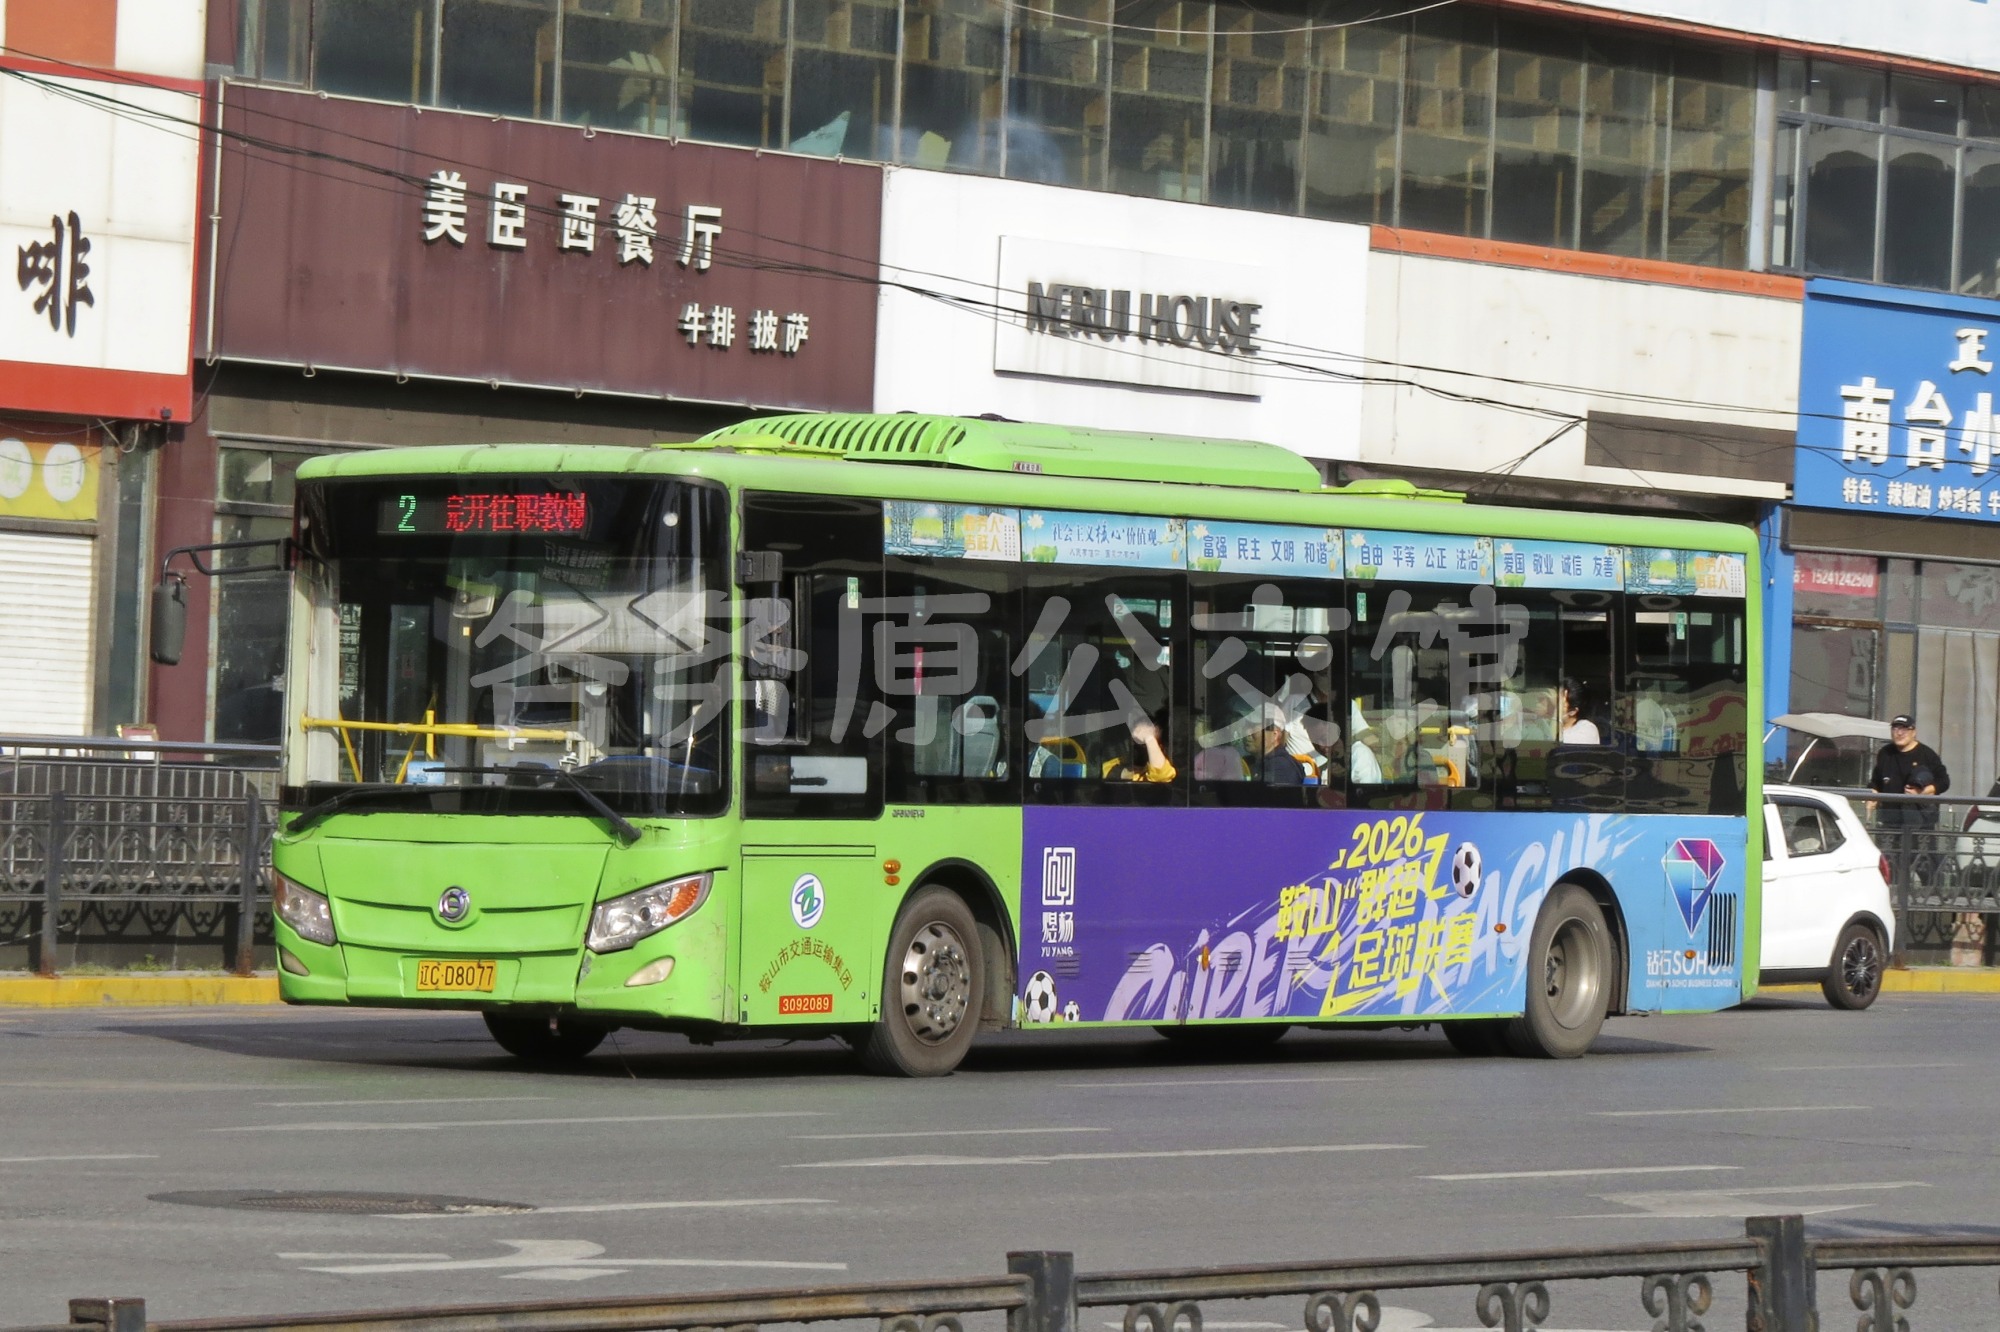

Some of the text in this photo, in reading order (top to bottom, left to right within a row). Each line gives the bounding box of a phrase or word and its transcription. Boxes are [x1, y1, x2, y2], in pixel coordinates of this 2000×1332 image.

[423, 170, 722, 272] 美臣西餐厅
[18, 210, 94, 338] 啡
[679, 303, 809, 354] 牛排 披萨
[1139, 293, 1262, 354] HOUSE
[399, 495, 417, 531] 2
[1053, 521, 1160, 546] 社会主义核心价值观
[1203, 535, 1328, 564] 富强 民主 文明 和谐
[1361, 544, 1478, 570] 自由 平等 公正 法治
[1504, 553, 1613, 577] 爱国 敬业 诚信 友善
[1346, 812, 1425, 869] 2026
[759, 936, 853, 993] 鞍山市交通运输集团
[1041, 946, 1074, 957] YU YANG
[1348, 912, 1478, 992] 足球联赛
[782, 997, 830, 1011] 3092089
